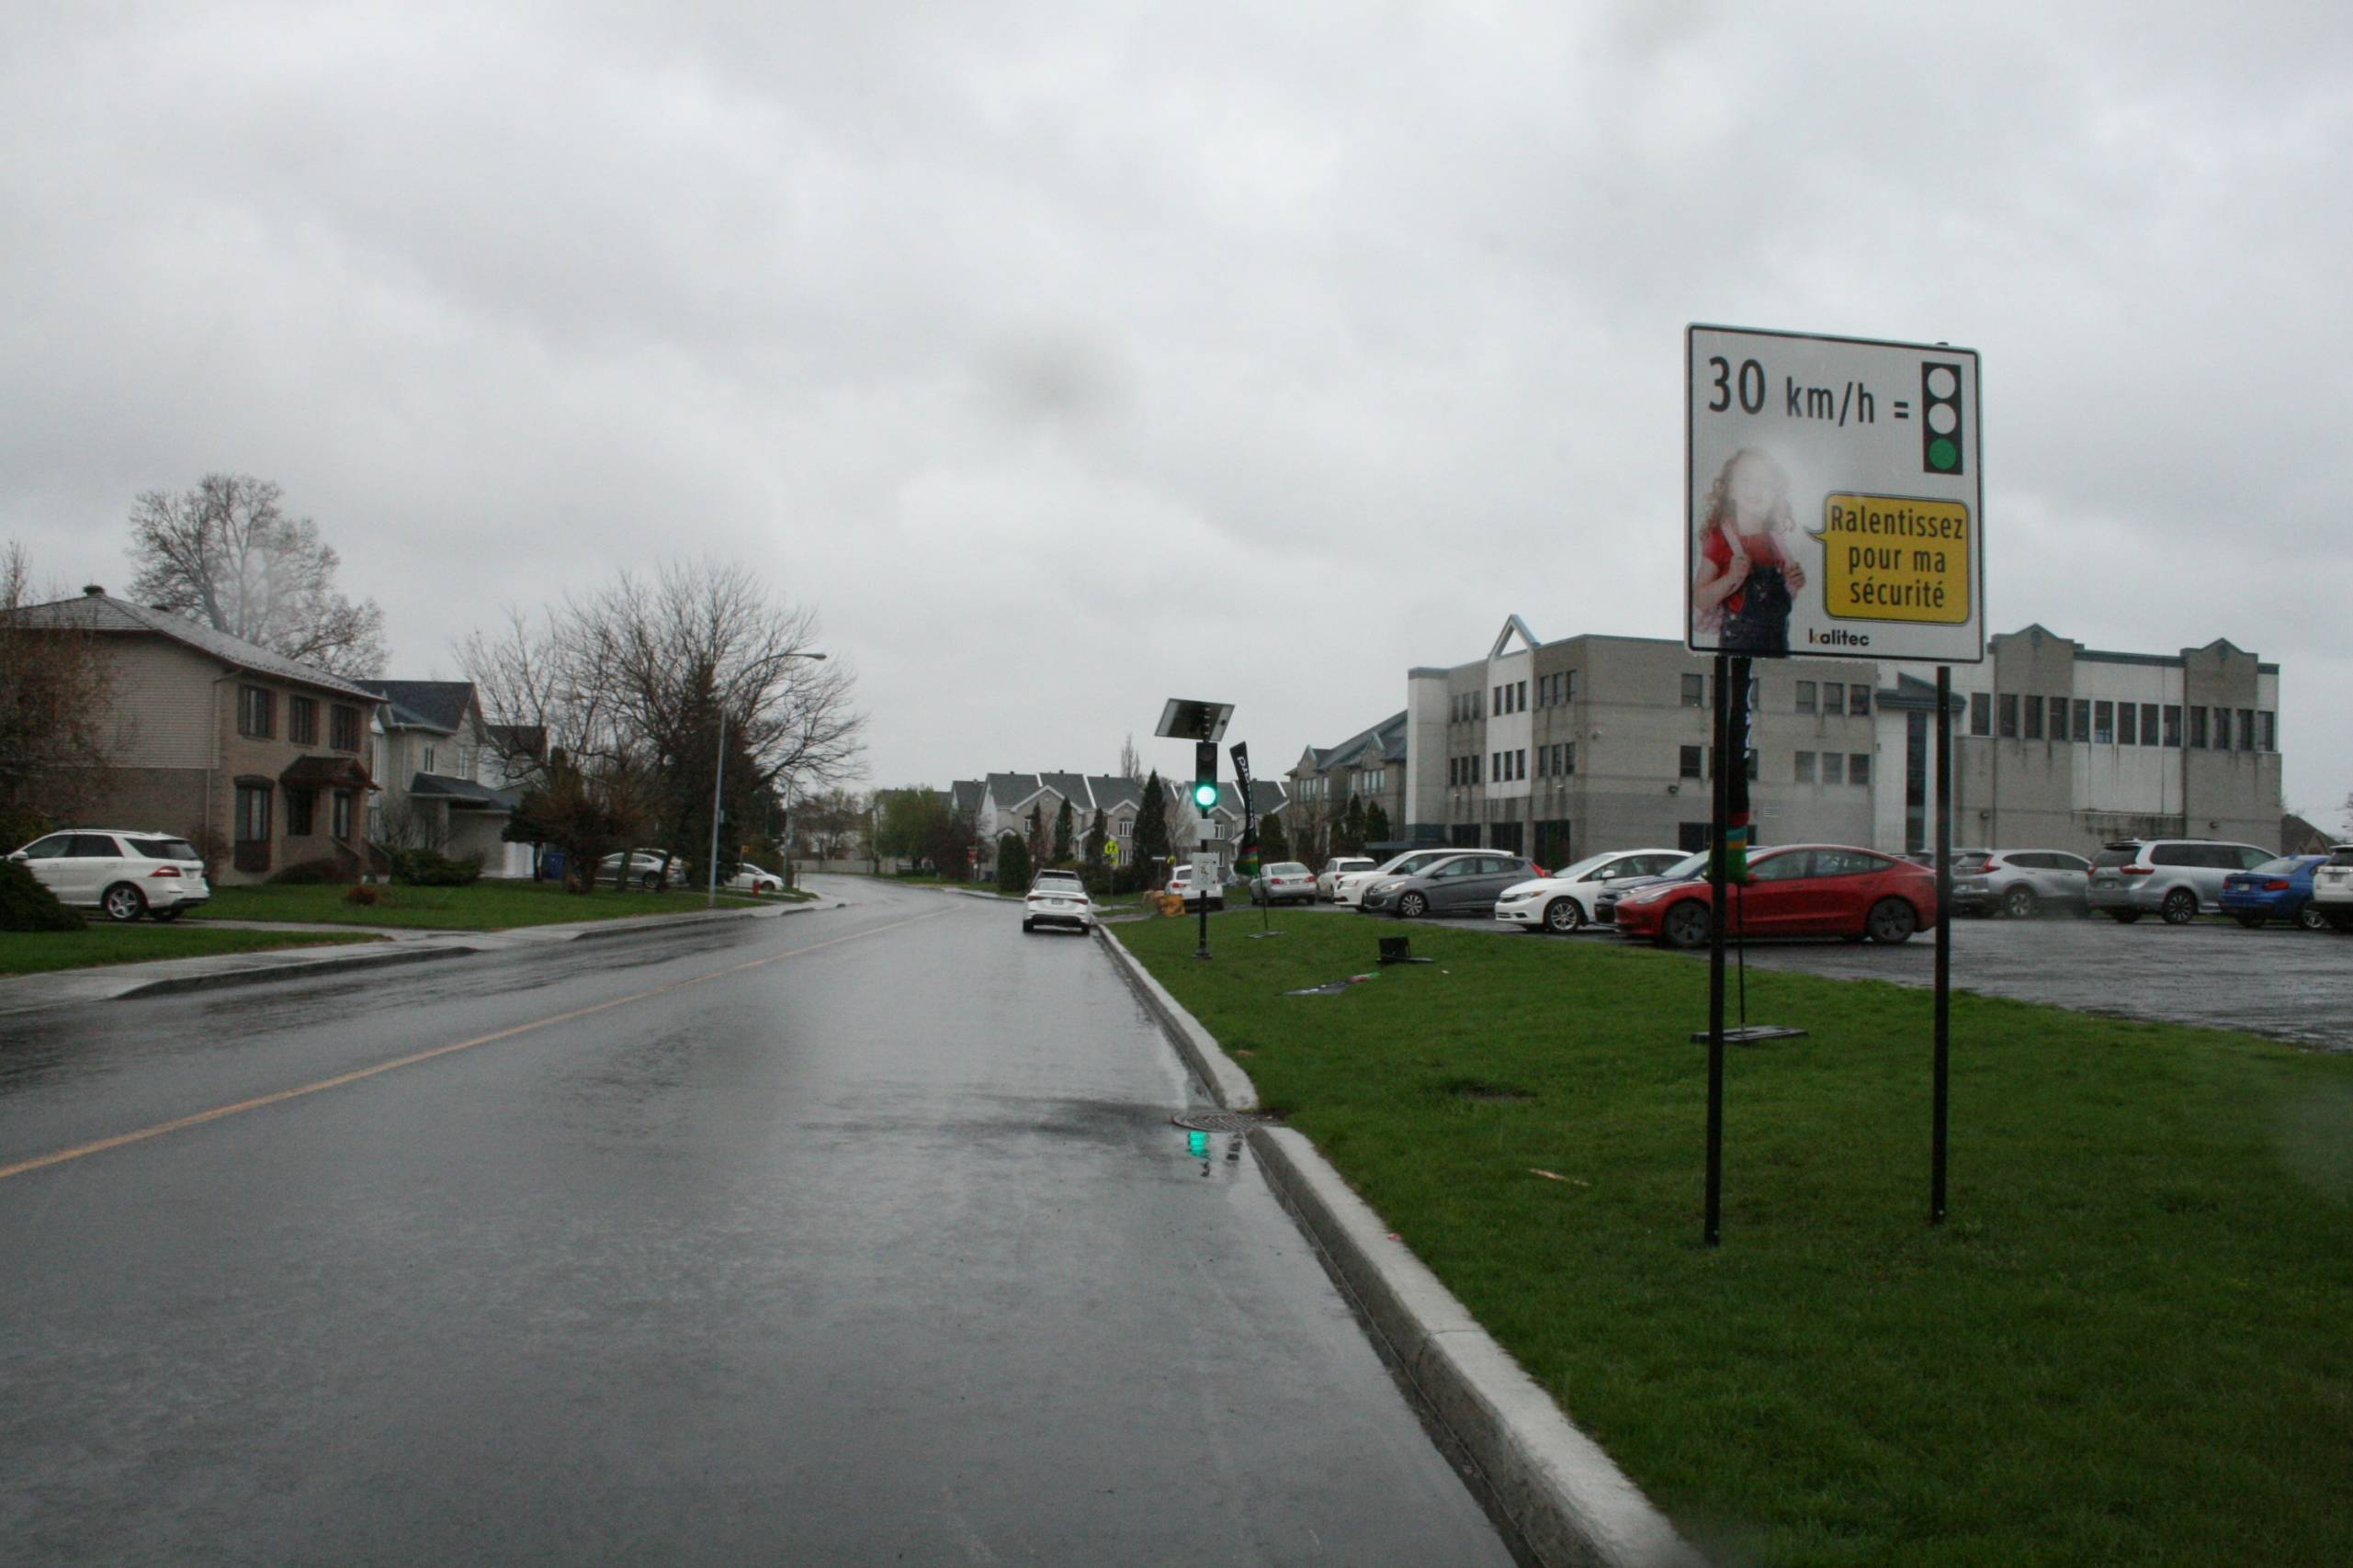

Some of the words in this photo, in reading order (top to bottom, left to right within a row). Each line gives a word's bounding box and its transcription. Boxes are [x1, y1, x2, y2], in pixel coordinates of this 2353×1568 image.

[1708, 355, 1766, 415] 30
[1785, 376, 1874, 427] km/h
[1893, 400, 1909, 419] =
[1831, 504, 1963, 540] Ralentissez
[1849, 546, 1902, 575] pour
[1913, 550, 1946, 573] ma
[1850, 576, 1945, 608] sécurité
[1808, 627, 1870, 647] kalitec
